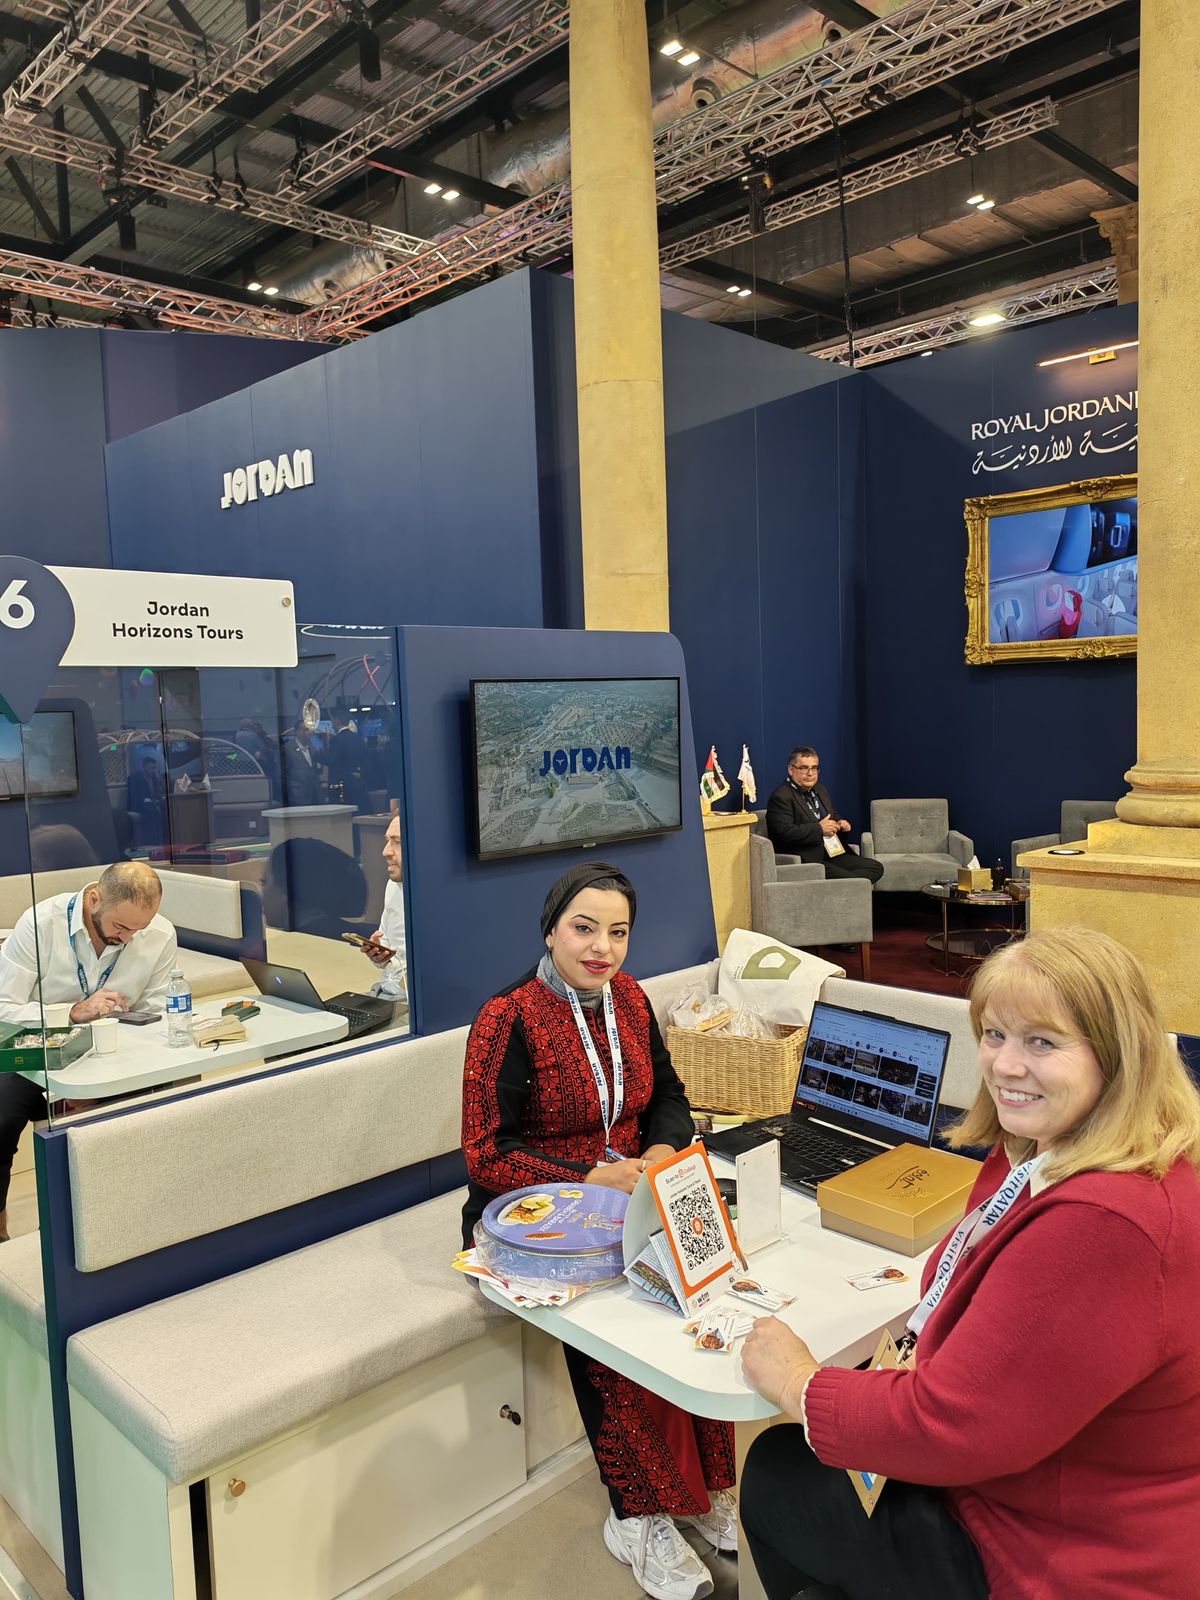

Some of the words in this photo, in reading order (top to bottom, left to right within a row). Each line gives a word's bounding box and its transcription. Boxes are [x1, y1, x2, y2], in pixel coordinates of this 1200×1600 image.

[971, 412, 1036, 441] ROYAL
[1033, 391, 1138, 432] JORDANI
[0, 579, 35, 630] 6
[147, 601, 209, 617] Jordan
[112, 622, 193, 639] Horizons
[196, 625, 244, 640] Tours
[982, 1161, 1033, 1226] visitQATAR
[936, 1231, 964, 1283] visitQA
